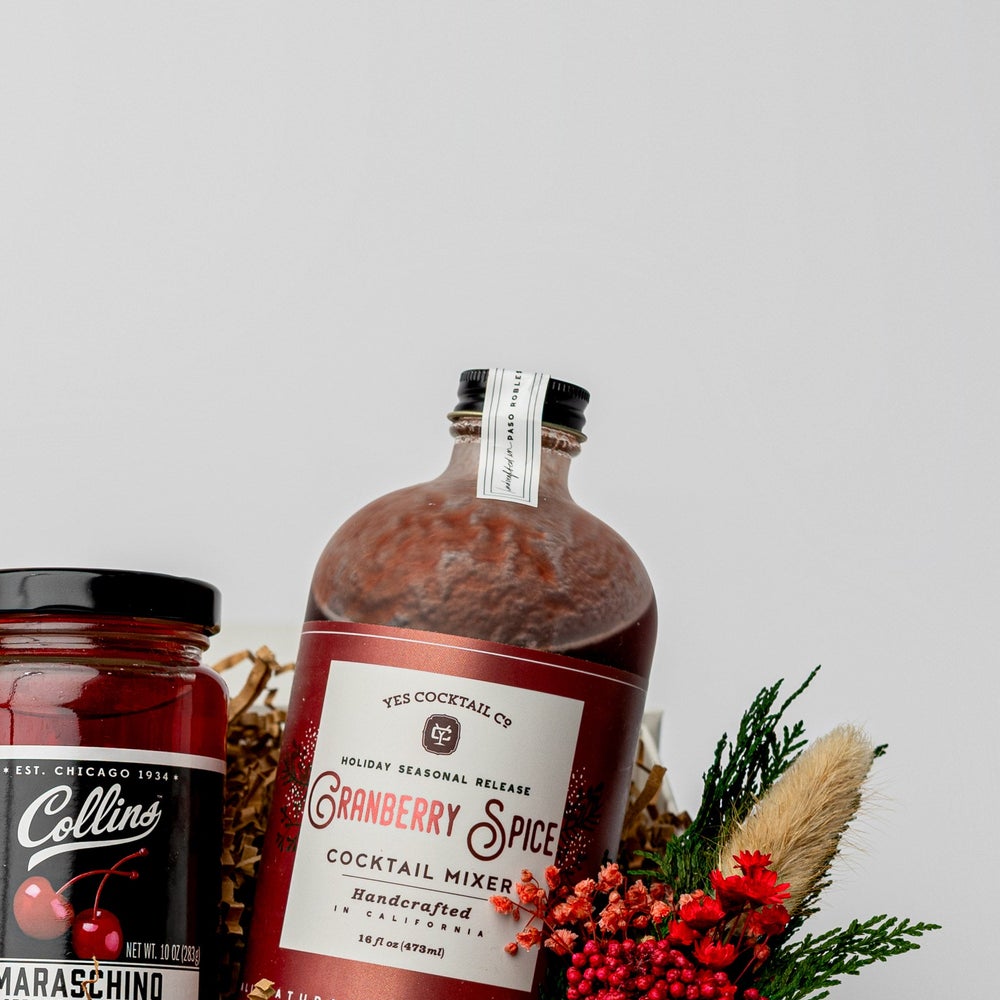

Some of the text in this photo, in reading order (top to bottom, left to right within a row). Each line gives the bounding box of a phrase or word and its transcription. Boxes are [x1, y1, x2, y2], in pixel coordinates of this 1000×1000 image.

[507, 413, 515, 441] PASO
[383, 693, 411, 709] YES
[414, 691, 491, 718] COCKTAIL
[15, 765, 169, 781] EST. CHICAGO 1934
[341, 756, 532, 797] HOLIDAY SEASONAL RELEASE
[17, 783, 162, 855] Collins
[308, 770, 558, 862] CRANBERRY SPICE
[326, 848, 513, 894] COCKTAIL MIXER
[351, 887, 473, 920] Handcrafted
[334, 904, 484, 938] IN CALIFORNIA
[125, 941, 201, 966] NET WT. 10 OZ (283g)
[358, 933, 445, 959] 16 fl oz (473ml)
